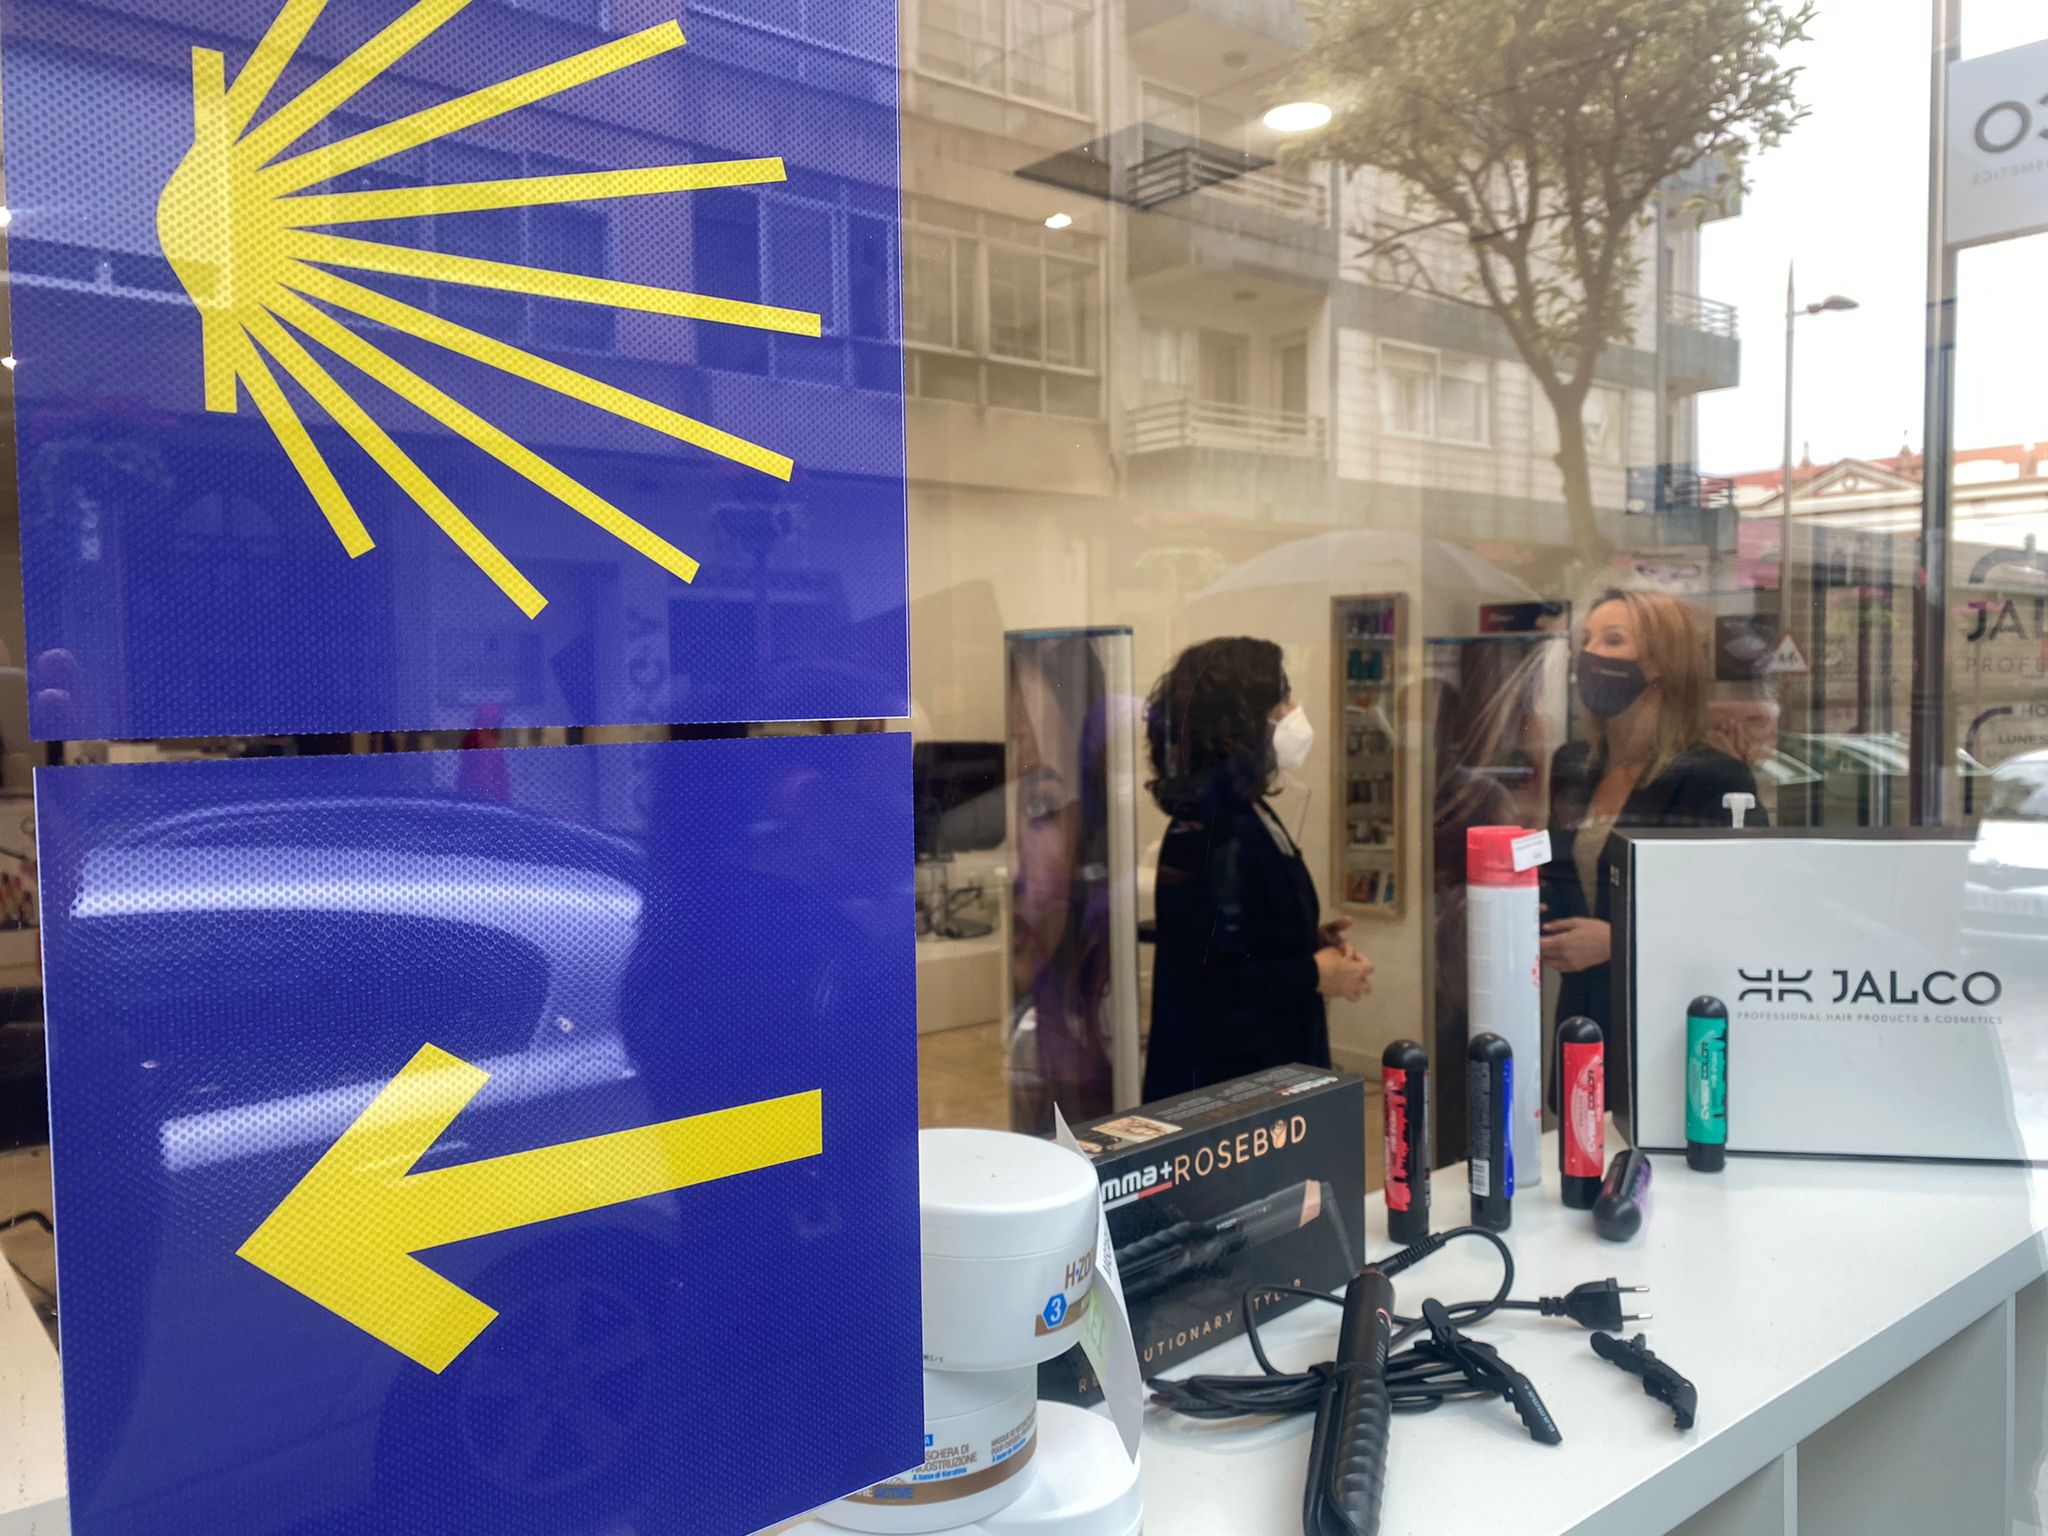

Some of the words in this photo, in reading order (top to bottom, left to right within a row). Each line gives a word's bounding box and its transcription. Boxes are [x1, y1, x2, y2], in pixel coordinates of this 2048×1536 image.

[1832, 969, 2002, 1006] JALCO
[1736, 1011, 1822, 1022] PROFESSIONAL
[1826, 1013, 1852, 1022] HAIR
[1856, 1013, 1919, 1024] PRODUCTS
[1934, 1016, 2003, 1026] COSMETICS
[1050, 1298, 1062, 1322] 3
